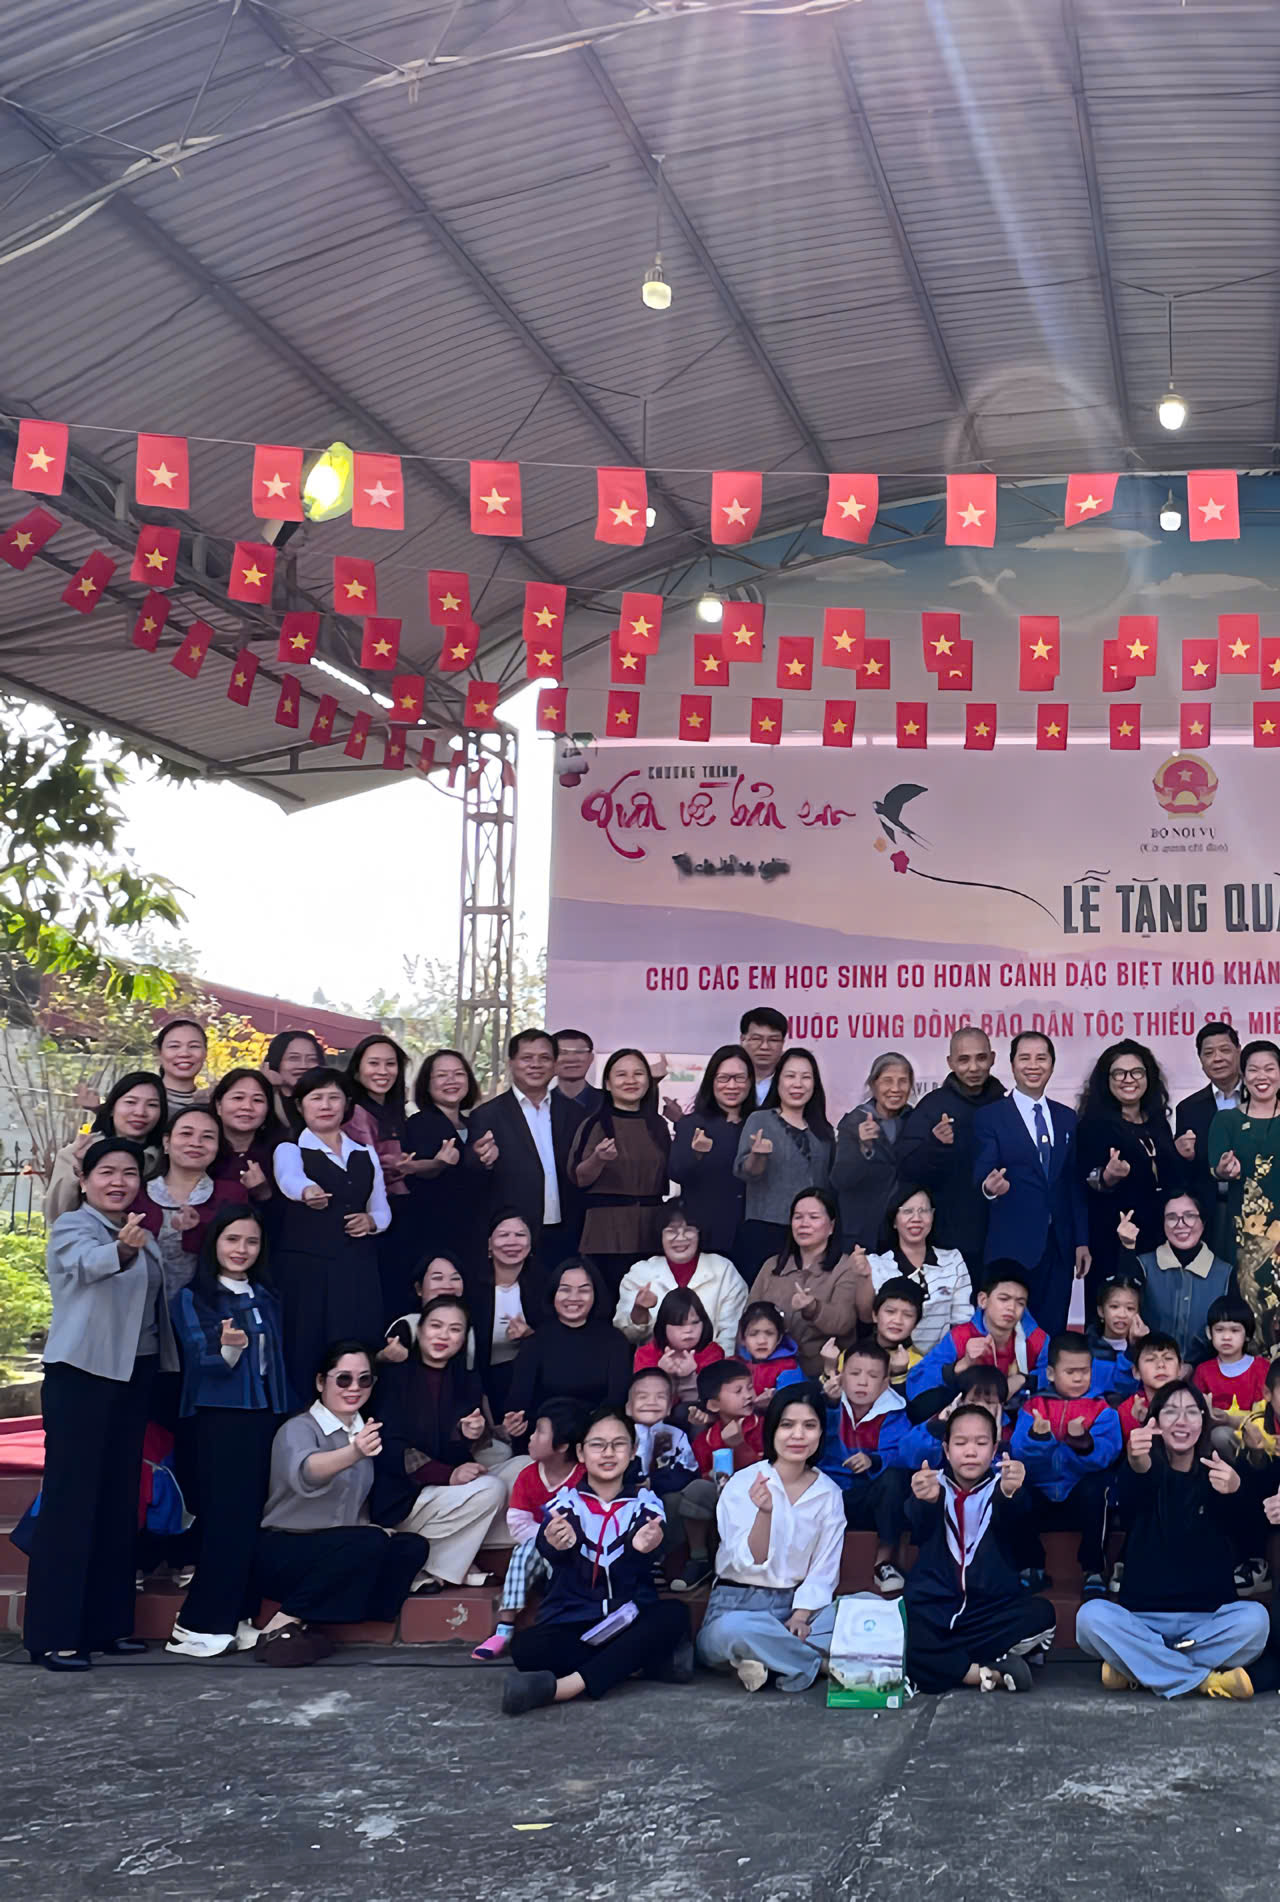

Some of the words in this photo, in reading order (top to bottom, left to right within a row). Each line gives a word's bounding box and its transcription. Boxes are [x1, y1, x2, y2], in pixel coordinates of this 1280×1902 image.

[1063, 869, 1111, 934] LỄ
[646, 966, 689, 991] CHO
[749, 965, 777, 990] EM
[785, 965, 828, 992] HỌC
[838, 964, 888, 989] SINH
